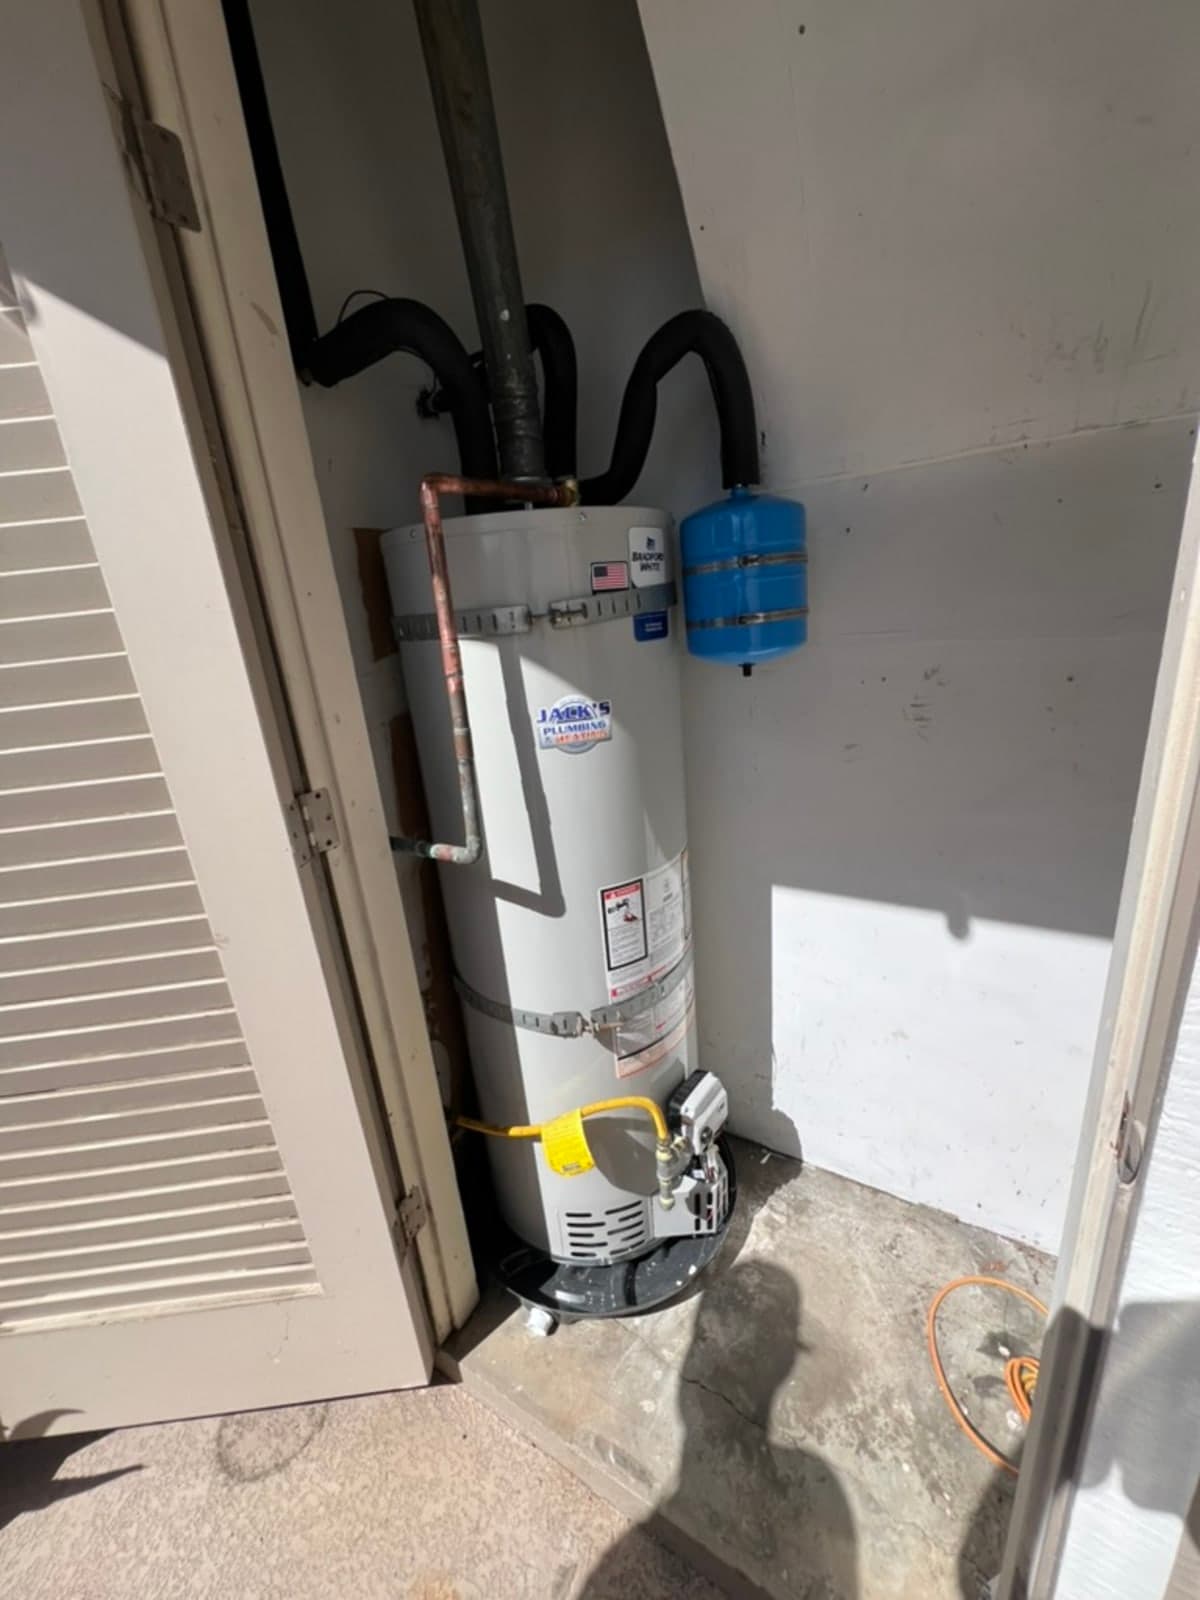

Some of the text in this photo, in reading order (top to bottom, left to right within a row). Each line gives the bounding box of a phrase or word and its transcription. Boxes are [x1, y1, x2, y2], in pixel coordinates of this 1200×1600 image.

[640, 562, 661, 572] WHITE
[537, 701, 610, 722] JACK'S
[543, 721, 606, 734] PLUMBING
